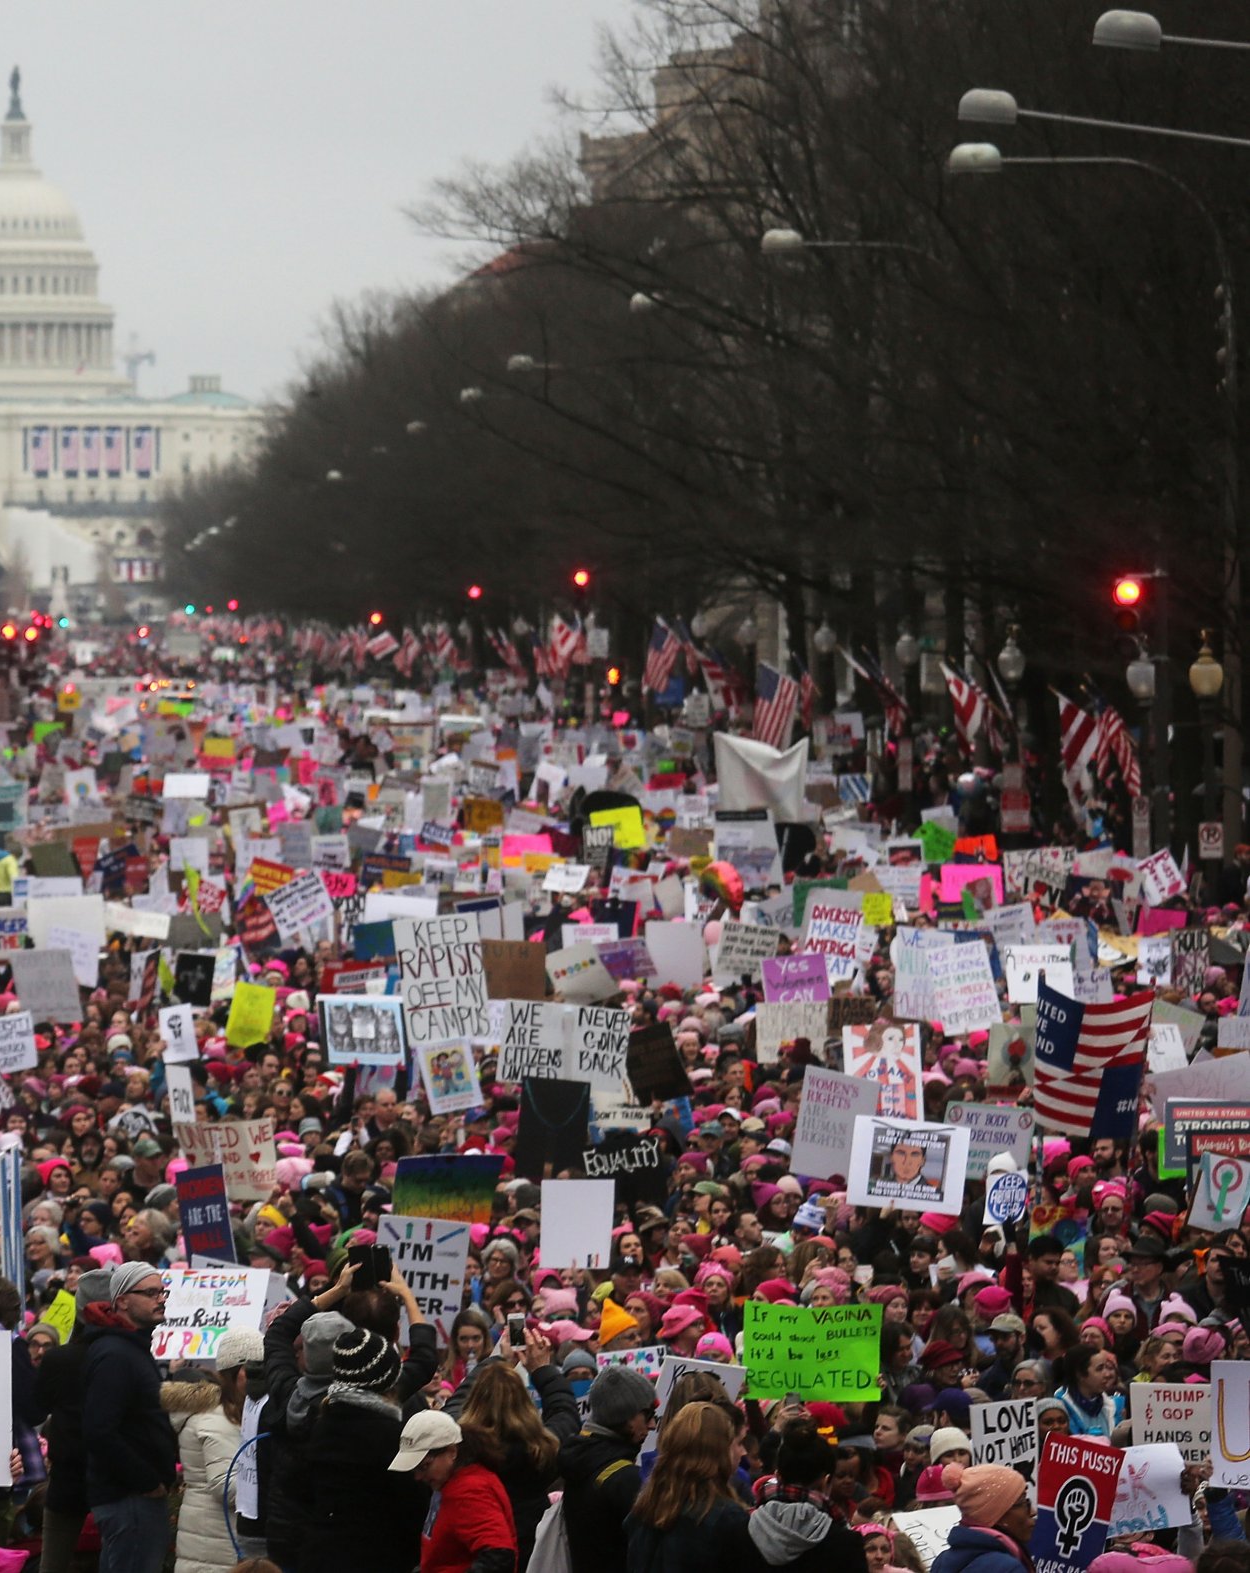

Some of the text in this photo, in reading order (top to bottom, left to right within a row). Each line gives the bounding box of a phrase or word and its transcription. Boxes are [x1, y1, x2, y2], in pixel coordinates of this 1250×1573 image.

[812, 905, 864, 926] DIVERSITY
[412, 918, 467, 948] KEEP
[811, 922, 857, 940] MAKES
[805, 938, 856, 959] AMERICA
[397, 942, 484, 980] RAPISTS
[775, 957, 810, 976] Yes
[407, 976, 484, 1012] OFF MY
[409, 1006, 491, 1041] CAMPUS
[510, 1001, 631, 1032] WE NEVER
[505, 1026, 540, 1046] ARE
[504, 1047, 623, 1080] CITIZENS BACK
[807, 1074, 860, 1099] WOMEN'S
[806, 1088, 852, 1111] RIGHTS
[804, 1103, 830, 1118] ARE
[965, 1112, 1011, 1127] MY BODY
[248, 1124, 272, 1145] WE
[801, 1115, 847, 1136] HUMAN
[800, 1130, 846, 1149] RIGHTS
[970, 1129, 1018, 1145] DECISION
[582, 1137, 660, 1177] EQUALITY
[999, 1174, 1022, 1188] KEEP
[990, 1188, 1027, 1203] ABORTION
[397, 1241, 434, 1263] I'M
[401, 1270, 450, 1291] ITH
[414, 1296, 444, 1316] ER
[811, 1308, 873, 1325] VAGINA
[825, 1326, 877, 1341] BULLETS
[788, 1347, 803, 1360] be
[745, 1368, 872, 1390] REGULATED
[1153, 1389, 1205, 1402] TRUMP
[982, 1401, 1036, 1435] LOVE
[1162, 1407, 1194, 1421] GOP
[1143, 1430, 1192, 1443] HANDS
[973, 1430, 1036, 1466] NOT HATE
[1049, 1441, 1120, 1476] THIS PUSSY
[1182, 1449, 1211, 1461] MEN
